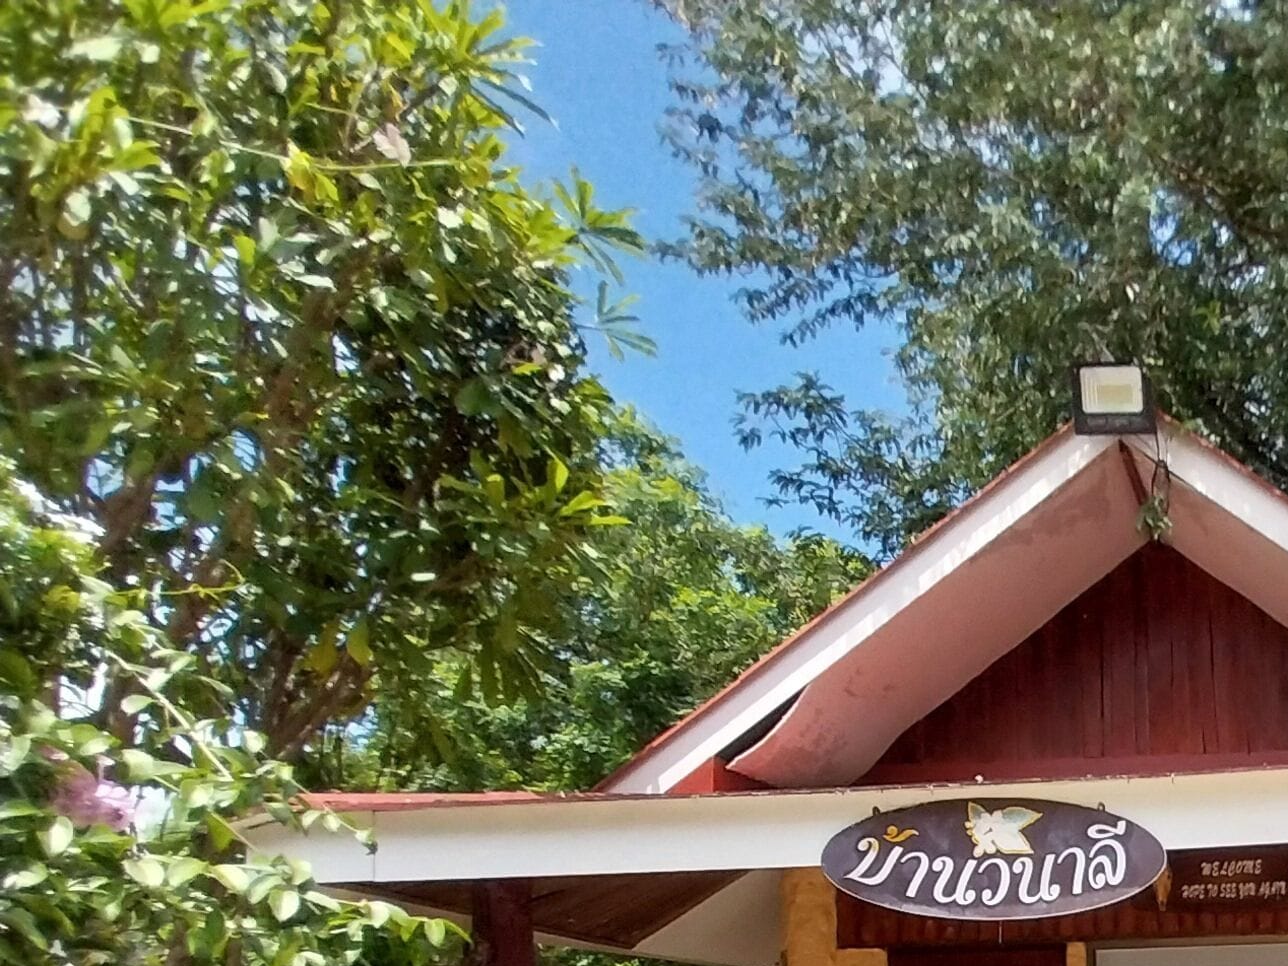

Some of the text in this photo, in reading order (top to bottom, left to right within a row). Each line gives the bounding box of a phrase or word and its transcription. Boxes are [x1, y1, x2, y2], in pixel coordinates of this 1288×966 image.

[844, 820, 1127, 906] บ้านวนาลี
[1201, 859, 1262, 876] WELCOME
[1220, 883, 1237, 898] SEE
